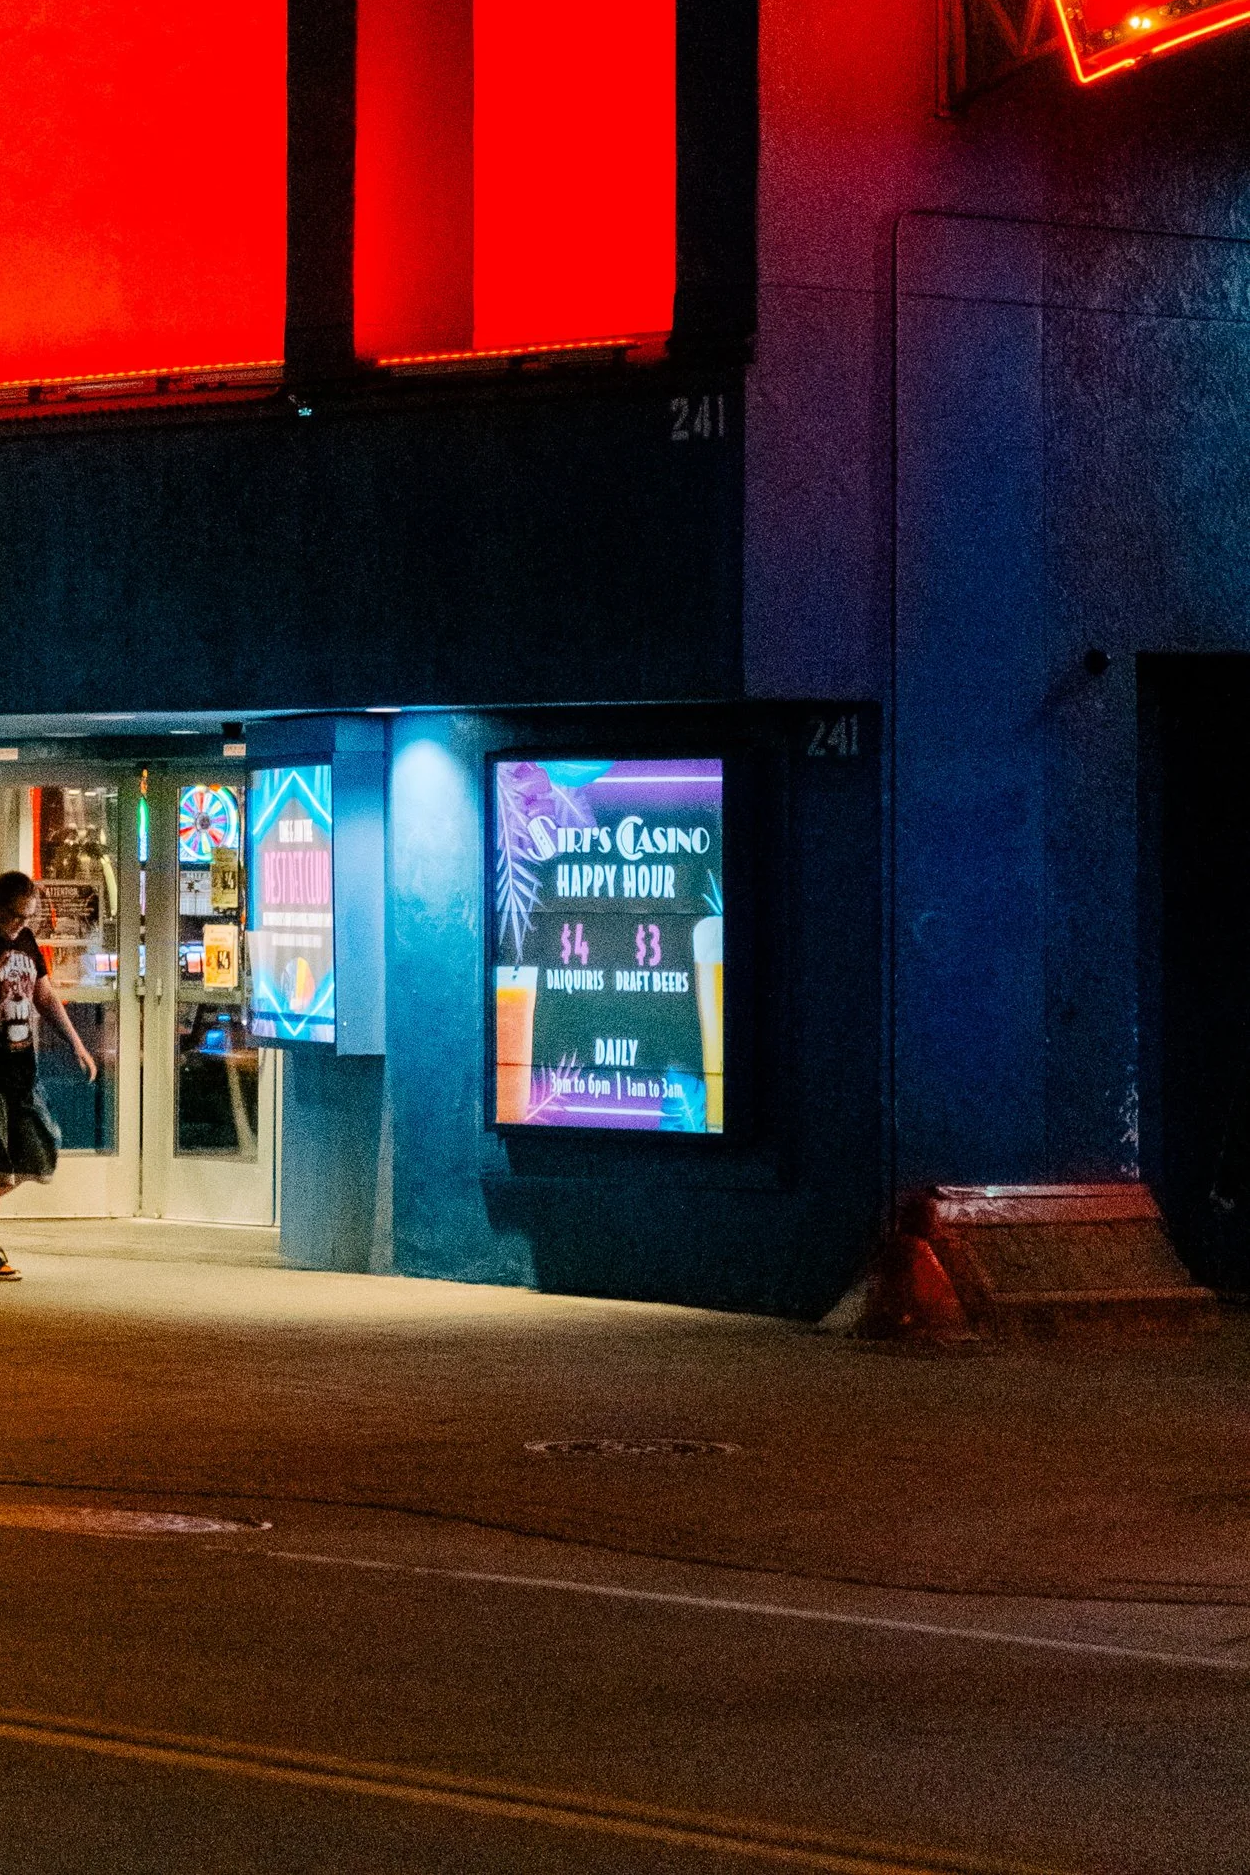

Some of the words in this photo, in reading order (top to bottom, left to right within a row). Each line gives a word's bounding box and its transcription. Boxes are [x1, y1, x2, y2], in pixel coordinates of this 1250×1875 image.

[671, 394, 725, 441] 241
[807, 713, 859, 757] 241
[527, 815, 612, 862] SIRI'S
[615, 815, 710, 862] CASINO
[264, 850, 287, 904] BEST
[305, 850, 330, 904] CLUB
[556, 864, 617, 898] HAPPY
[623, 864, 676, 899] HOUR
[560, 923, 589, 966] $4
[635, 923, 663, 967] $3
[546, 968, 605, 995] DAIQUIRIS
[615, 970, 650, 992] DRAFT
[652, 971, 690, 993] BEERS
[594, 1038, 639, 1067] DAILY
[550, 1072, 572, 1096] 3pm
[573, 1075, 586, 1094] to
[587, 1073, 611, 1099] 6pm
[626, 1075, 648, 1097] 1am
[647, 1080, 660, 1098] to
[661, 1077, 684, 1099] 3am
